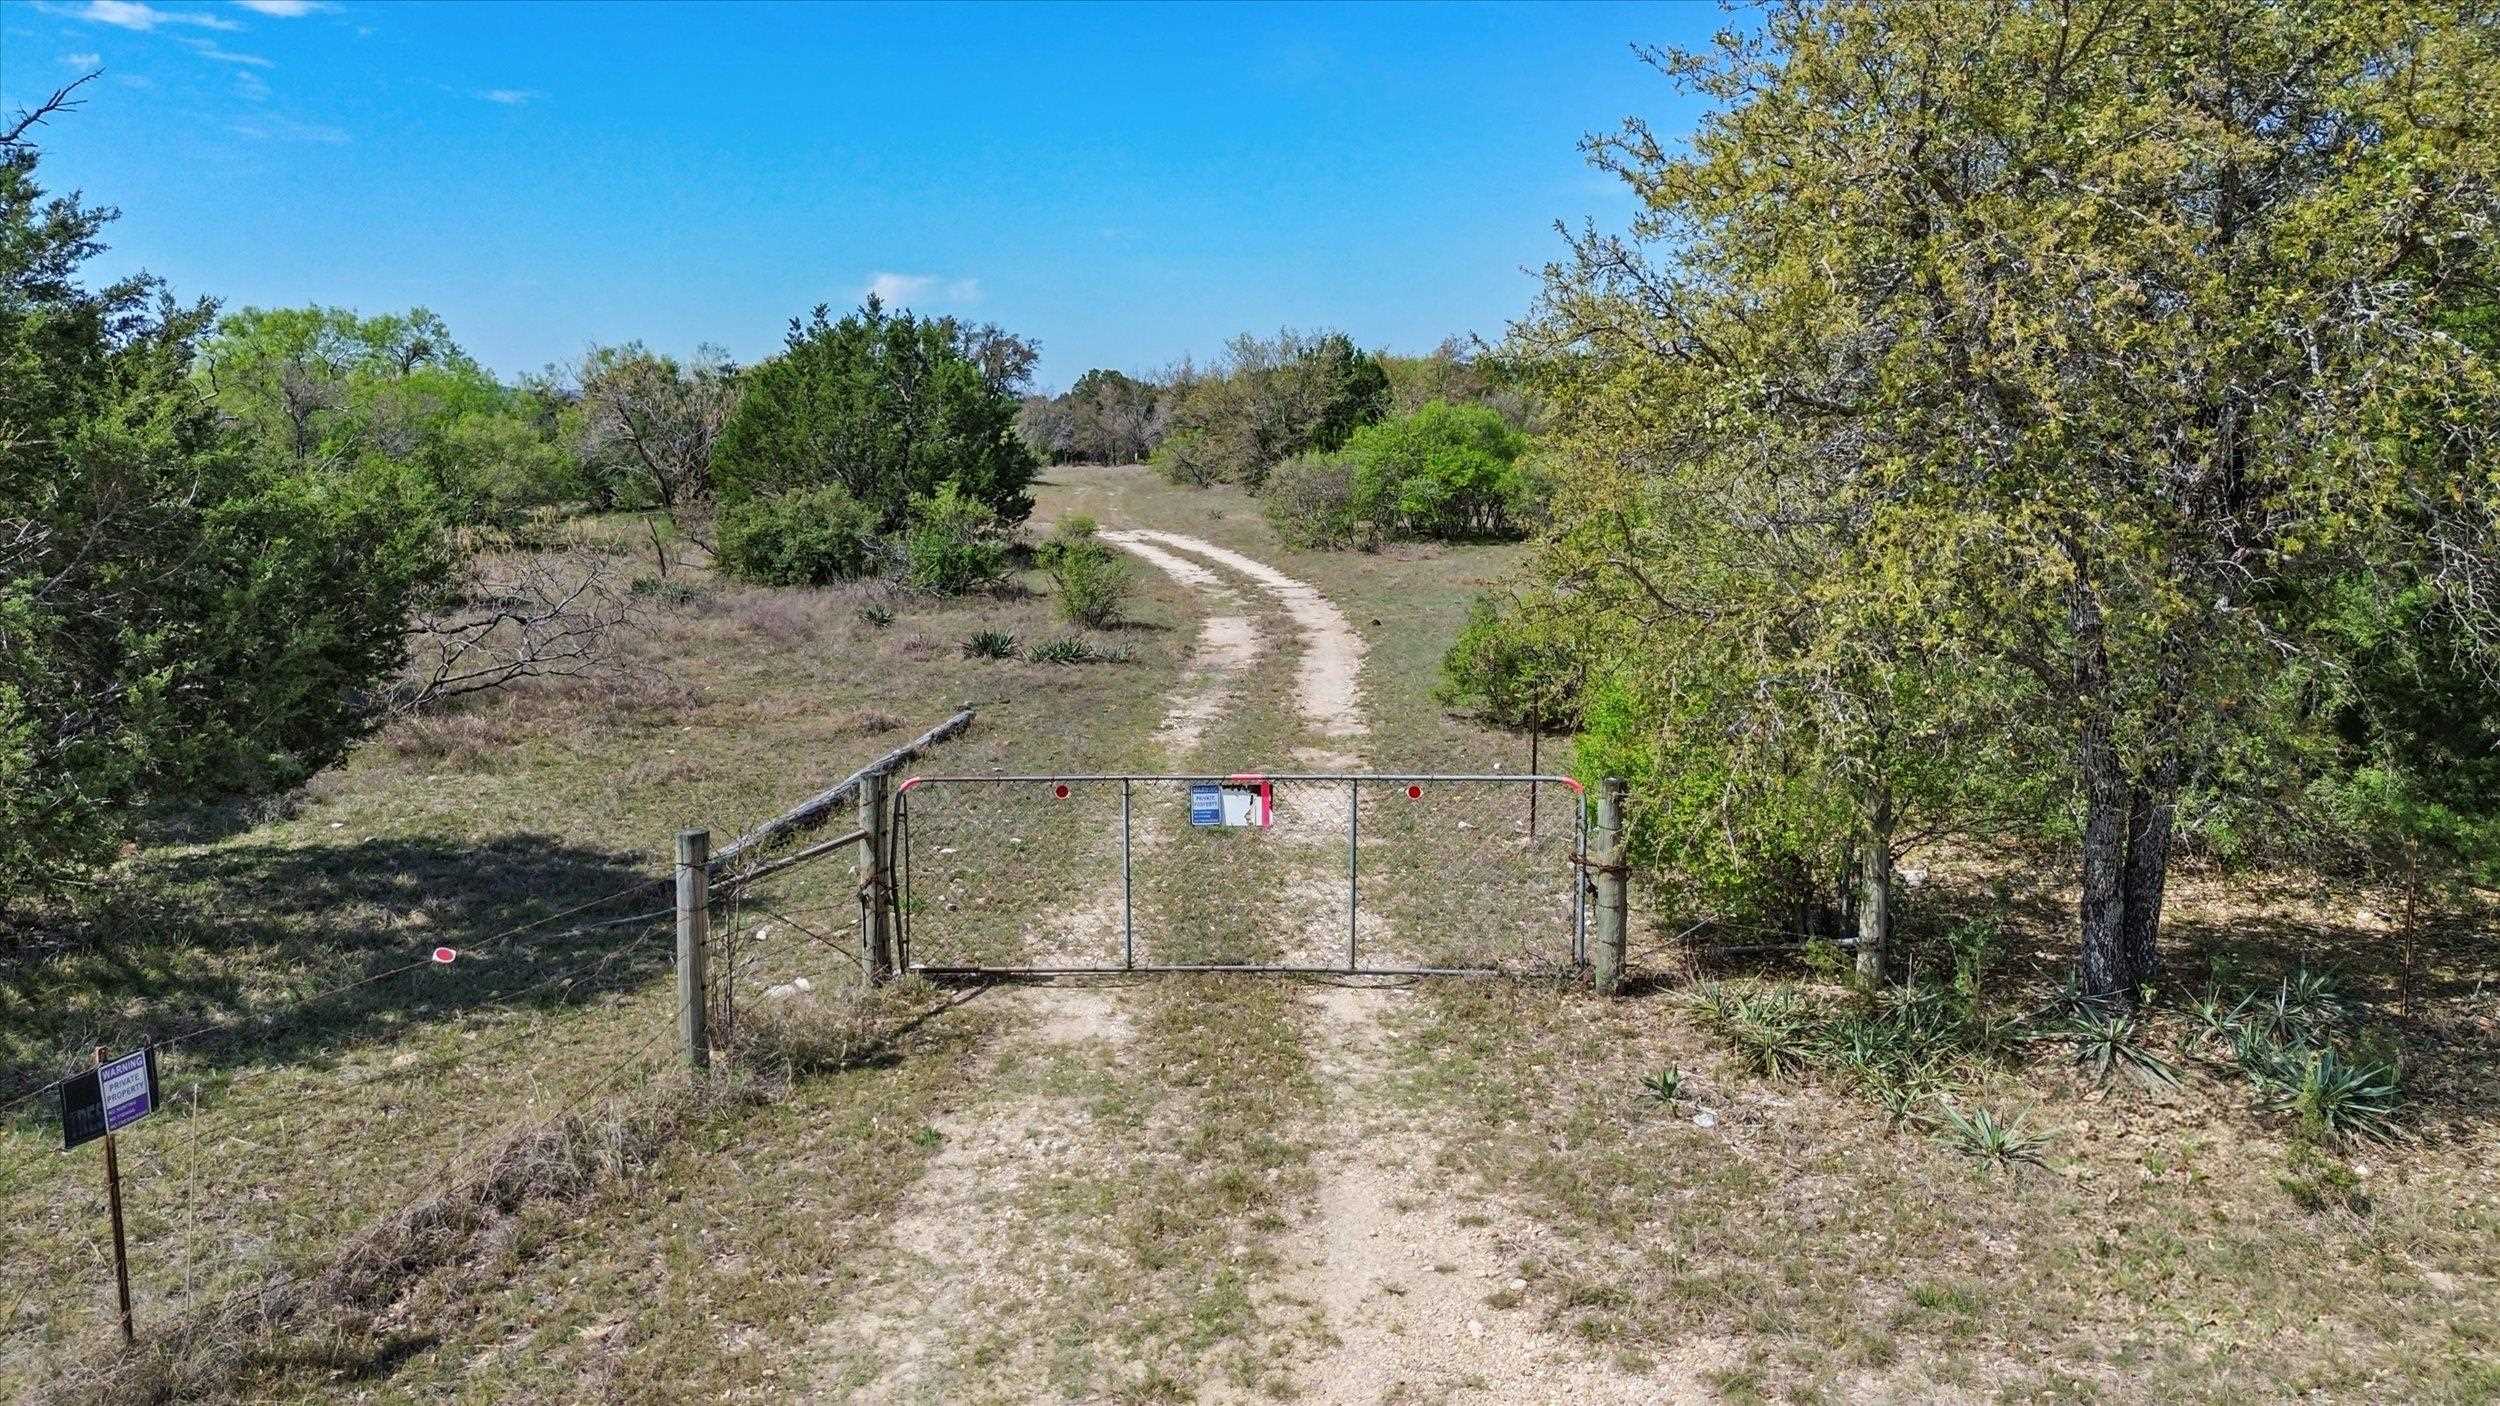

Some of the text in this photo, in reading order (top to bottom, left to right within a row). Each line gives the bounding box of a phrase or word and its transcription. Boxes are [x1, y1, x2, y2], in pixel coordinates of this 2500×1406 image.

[102, 1056, 143, 1079] WARNING
[107, 1082, 144, 1103] PROPERTY
[109, 1074, 140, 1091] PRIVATE
